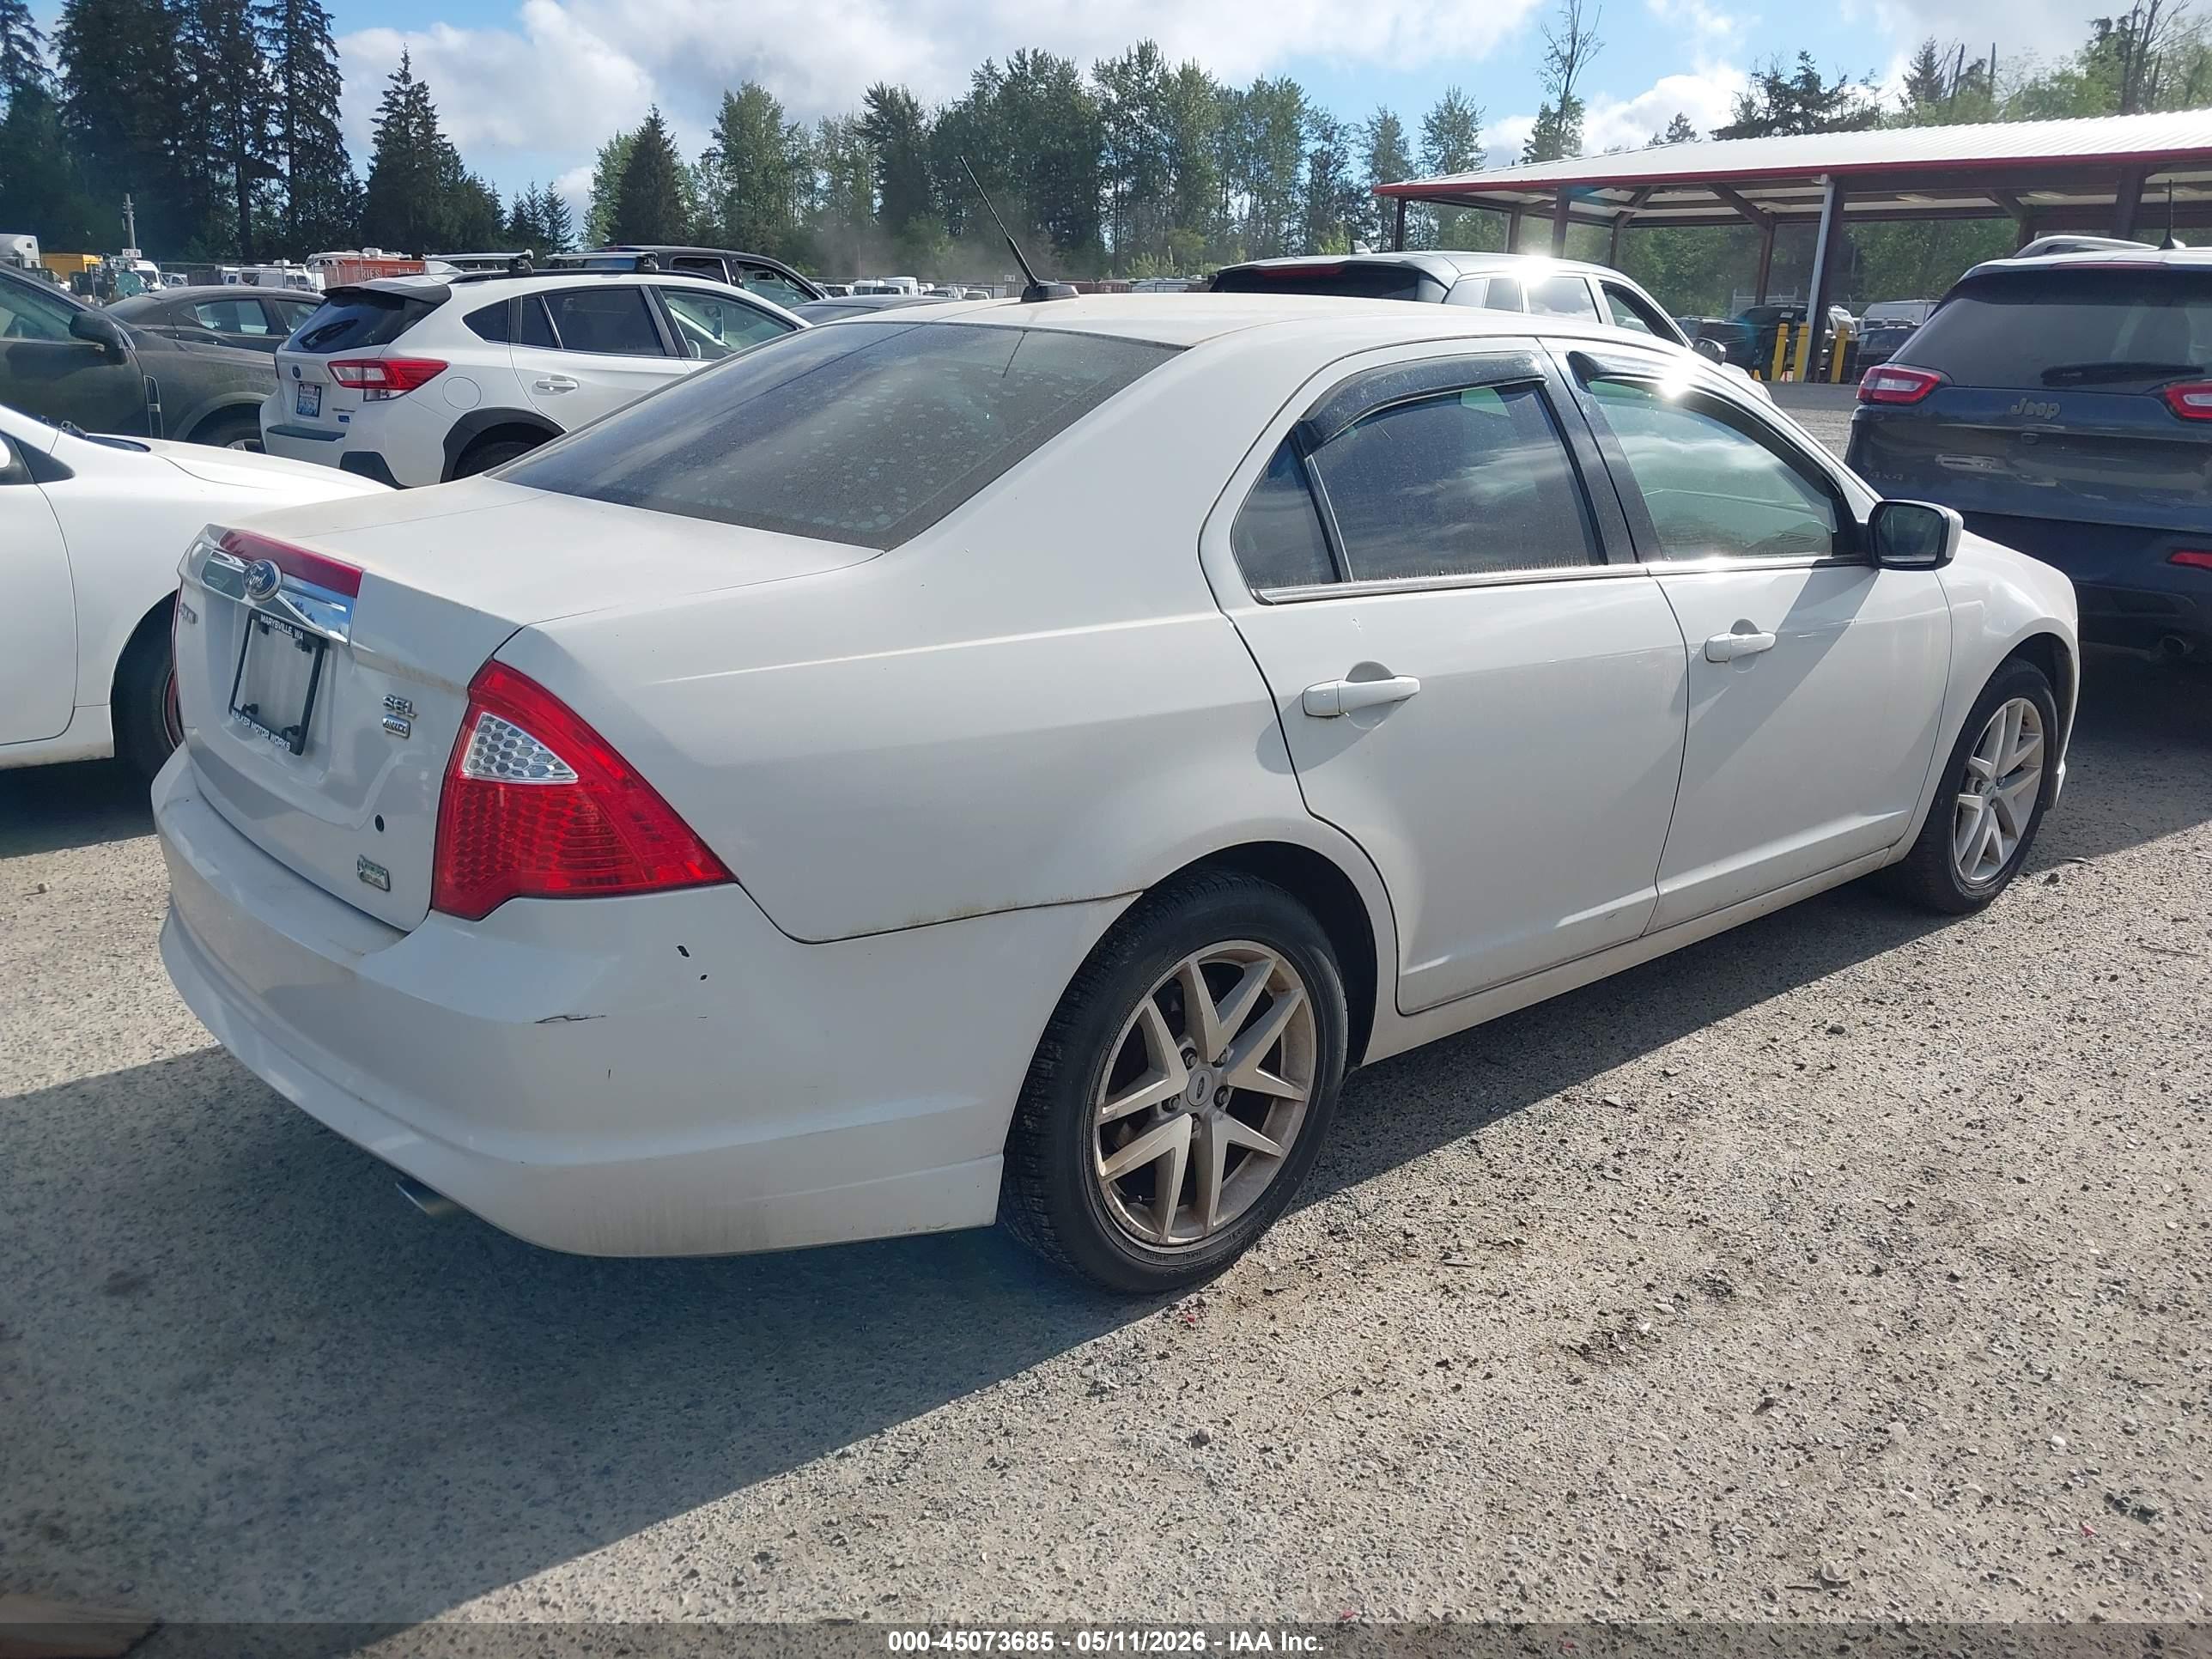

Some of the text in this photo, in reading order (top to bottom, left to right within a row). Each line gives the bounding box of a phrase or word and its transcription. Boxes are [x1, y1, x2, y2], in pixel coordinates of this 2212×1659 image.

[2009, 398, 2061, 420] Jeep
[246, 562, 268, 586] Ford
[294, 629, 304, 641] WA
[382, 693, 417, 719] SEL
[231, 708, 291, 751] WALKER MOTOR WORKS
[383, 719, 407, 734] AWD
